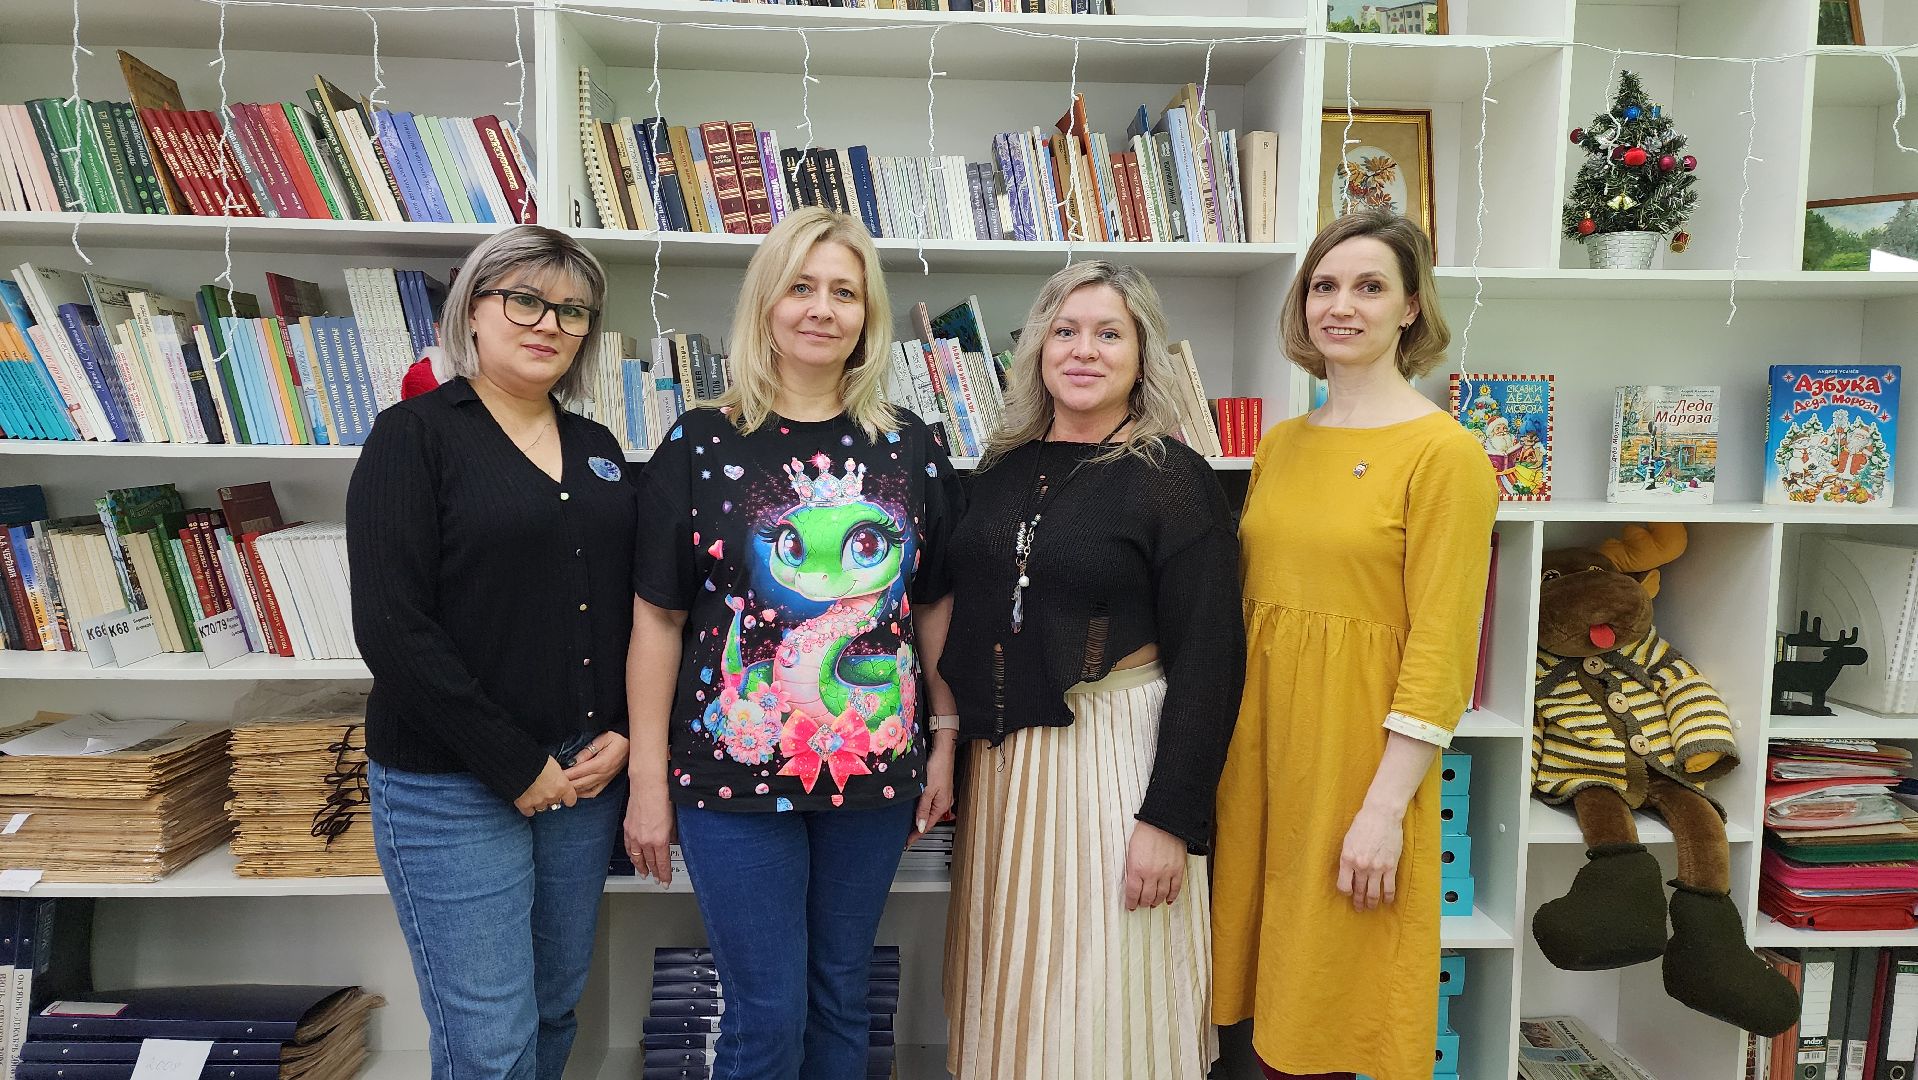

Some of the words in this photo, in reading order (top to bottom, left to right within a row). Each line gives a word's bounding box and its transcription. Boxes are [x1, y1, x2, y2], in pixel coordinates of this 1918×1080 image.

[316, 326, 335, 382] СОЛНЕЧНОГОРЬЕ
[331, 326, 350, 382] СОЛНЕЧНОГОРЬЕ
[346, 327, 365, 383] СОЛНЕЧНОГОРЬЕ
[695, 370, 706, 401] ТИЩЕВ
[1506, 384, 1542, 393] СКАЗКИ
[1506, 394, 1543, 403] ДЕДА
[1794, 375, 1881, 396] Азбука
[329, 382, 349, 435] ПРАВОСЛАВНОЕ
[344, 382, 363, 435] ПРАВОСЛАВНОЕ
[359, 382, 377, 427] АВОСЛАВНОЕ
[1505, 405, 1544, 414] МОРОЗА
[1674, 398, 1713, 413] Деда
[1794, 397, 1827, 414] Деда
[1831, 394, 1879, 414] Мороза
[1655, 411, 1712, 426] Мороза
[108, 621, 130, 637] К68
[198, 619, 228, 639] К70/79
[13, 974, 27, 1011] ОКТЯБРЬ
[9, 1016, 24, 1053] ДЕКАБРЬ
